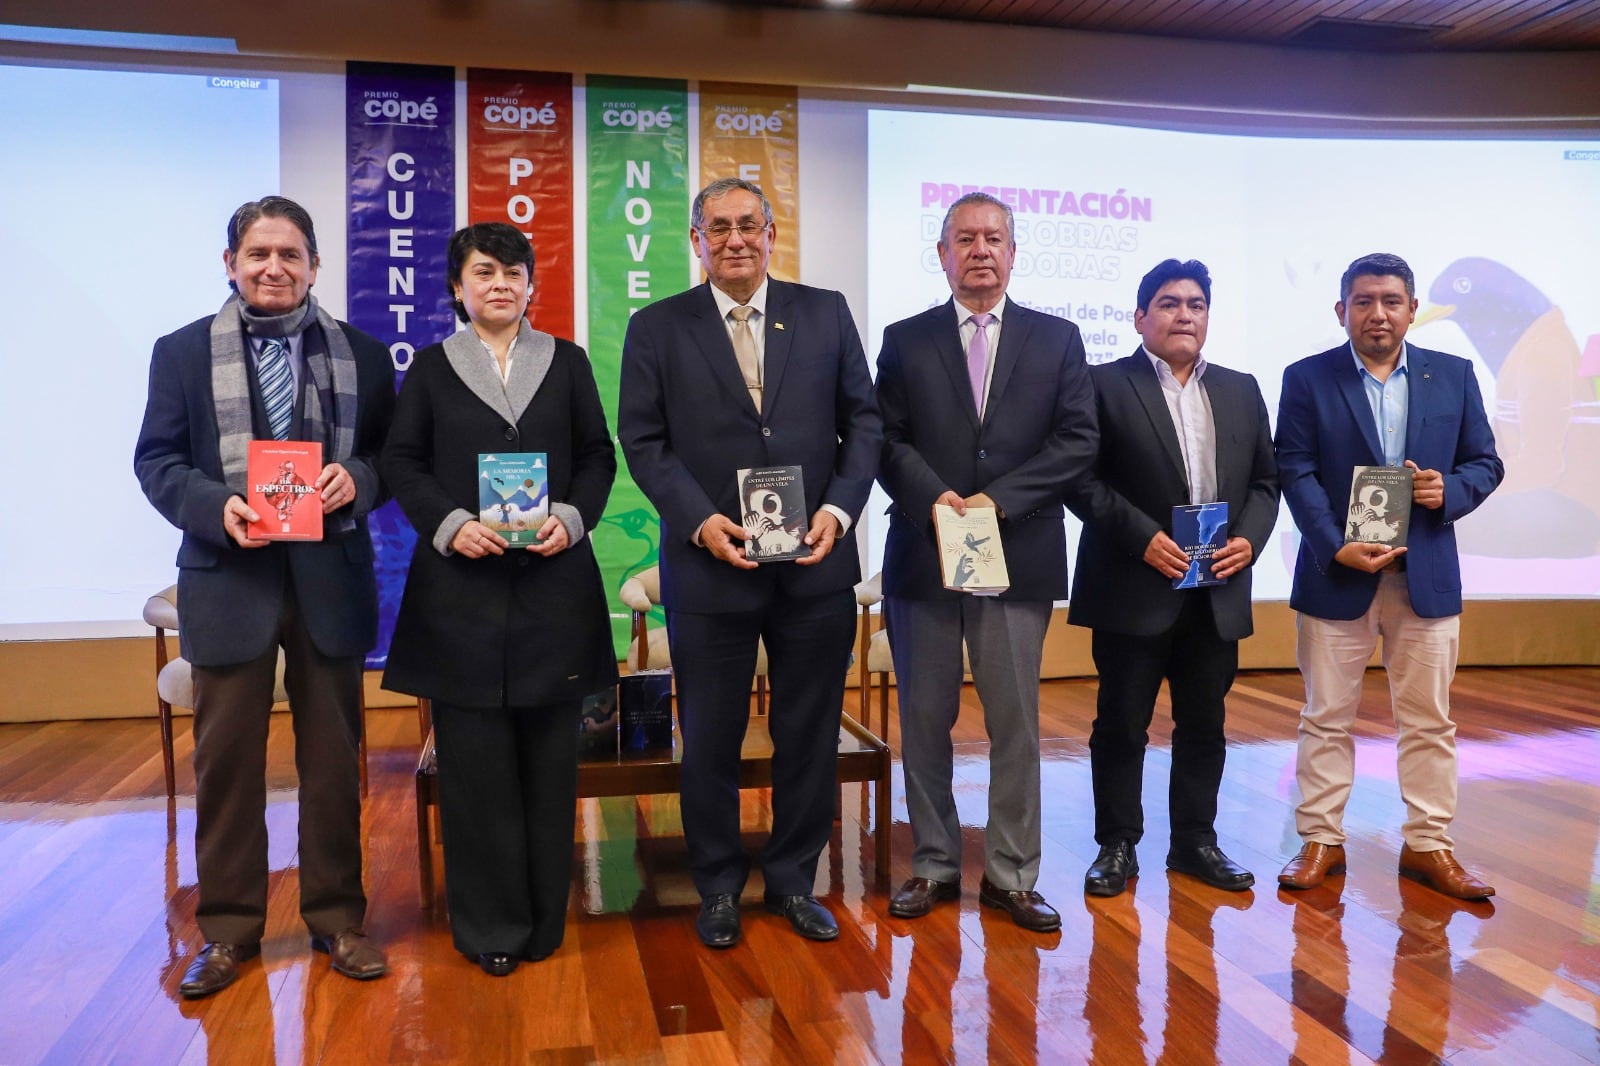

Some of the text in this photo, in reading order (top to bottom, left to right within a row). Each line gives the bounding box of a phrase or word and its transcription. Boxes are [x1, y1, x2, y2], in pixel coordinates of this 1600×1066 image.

[211, 77, 261, 89] Congelar
[364, 91, 399, 99] PREMIO
[484, 97, 519, 105] PREMIO
[364, 96, 439, 124] copé
[484, 102, 556, 129] copé
[602, 105, 673, 132] copé
[715, 105, 748, 113] PREMIO
[715, 110, 783, 136] copé
[1569, 151, 1600, 161] Conge
[624, 159, 652, 318] NOVE
[1034, 220, 1138, 252] OBRAS
[386, 152, 416, 371] CUENTO
[1076, 303, 1098, 320] de
[1103, 304, 1134, 322] Poe
[1081, 328, 1118, 346] vela
[255, 484, 315, 493] ESPECTROS
